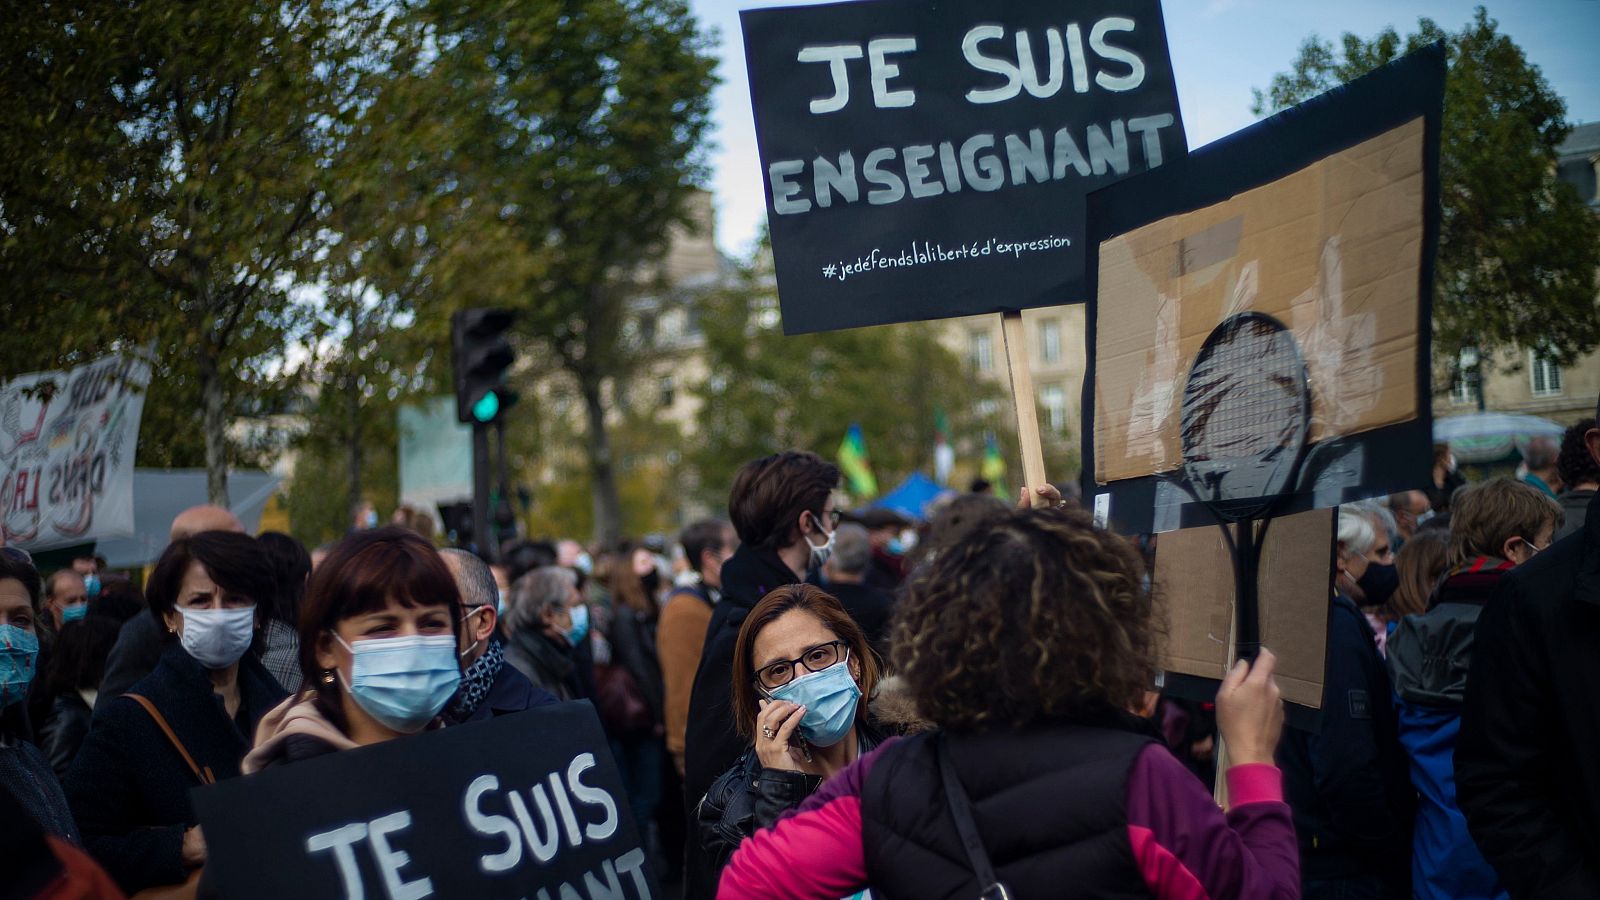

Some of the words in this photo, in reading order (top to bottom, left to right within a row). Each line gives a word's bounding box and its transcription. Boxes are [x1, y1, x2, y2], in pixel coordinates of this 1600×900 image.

[797, 37, 917, 114] JE
[962, 17, 1146, 104] SUIS
[769, 113, 1174, 215] ENSEIGNANT
[464, 752, 618, 871] SUIS
